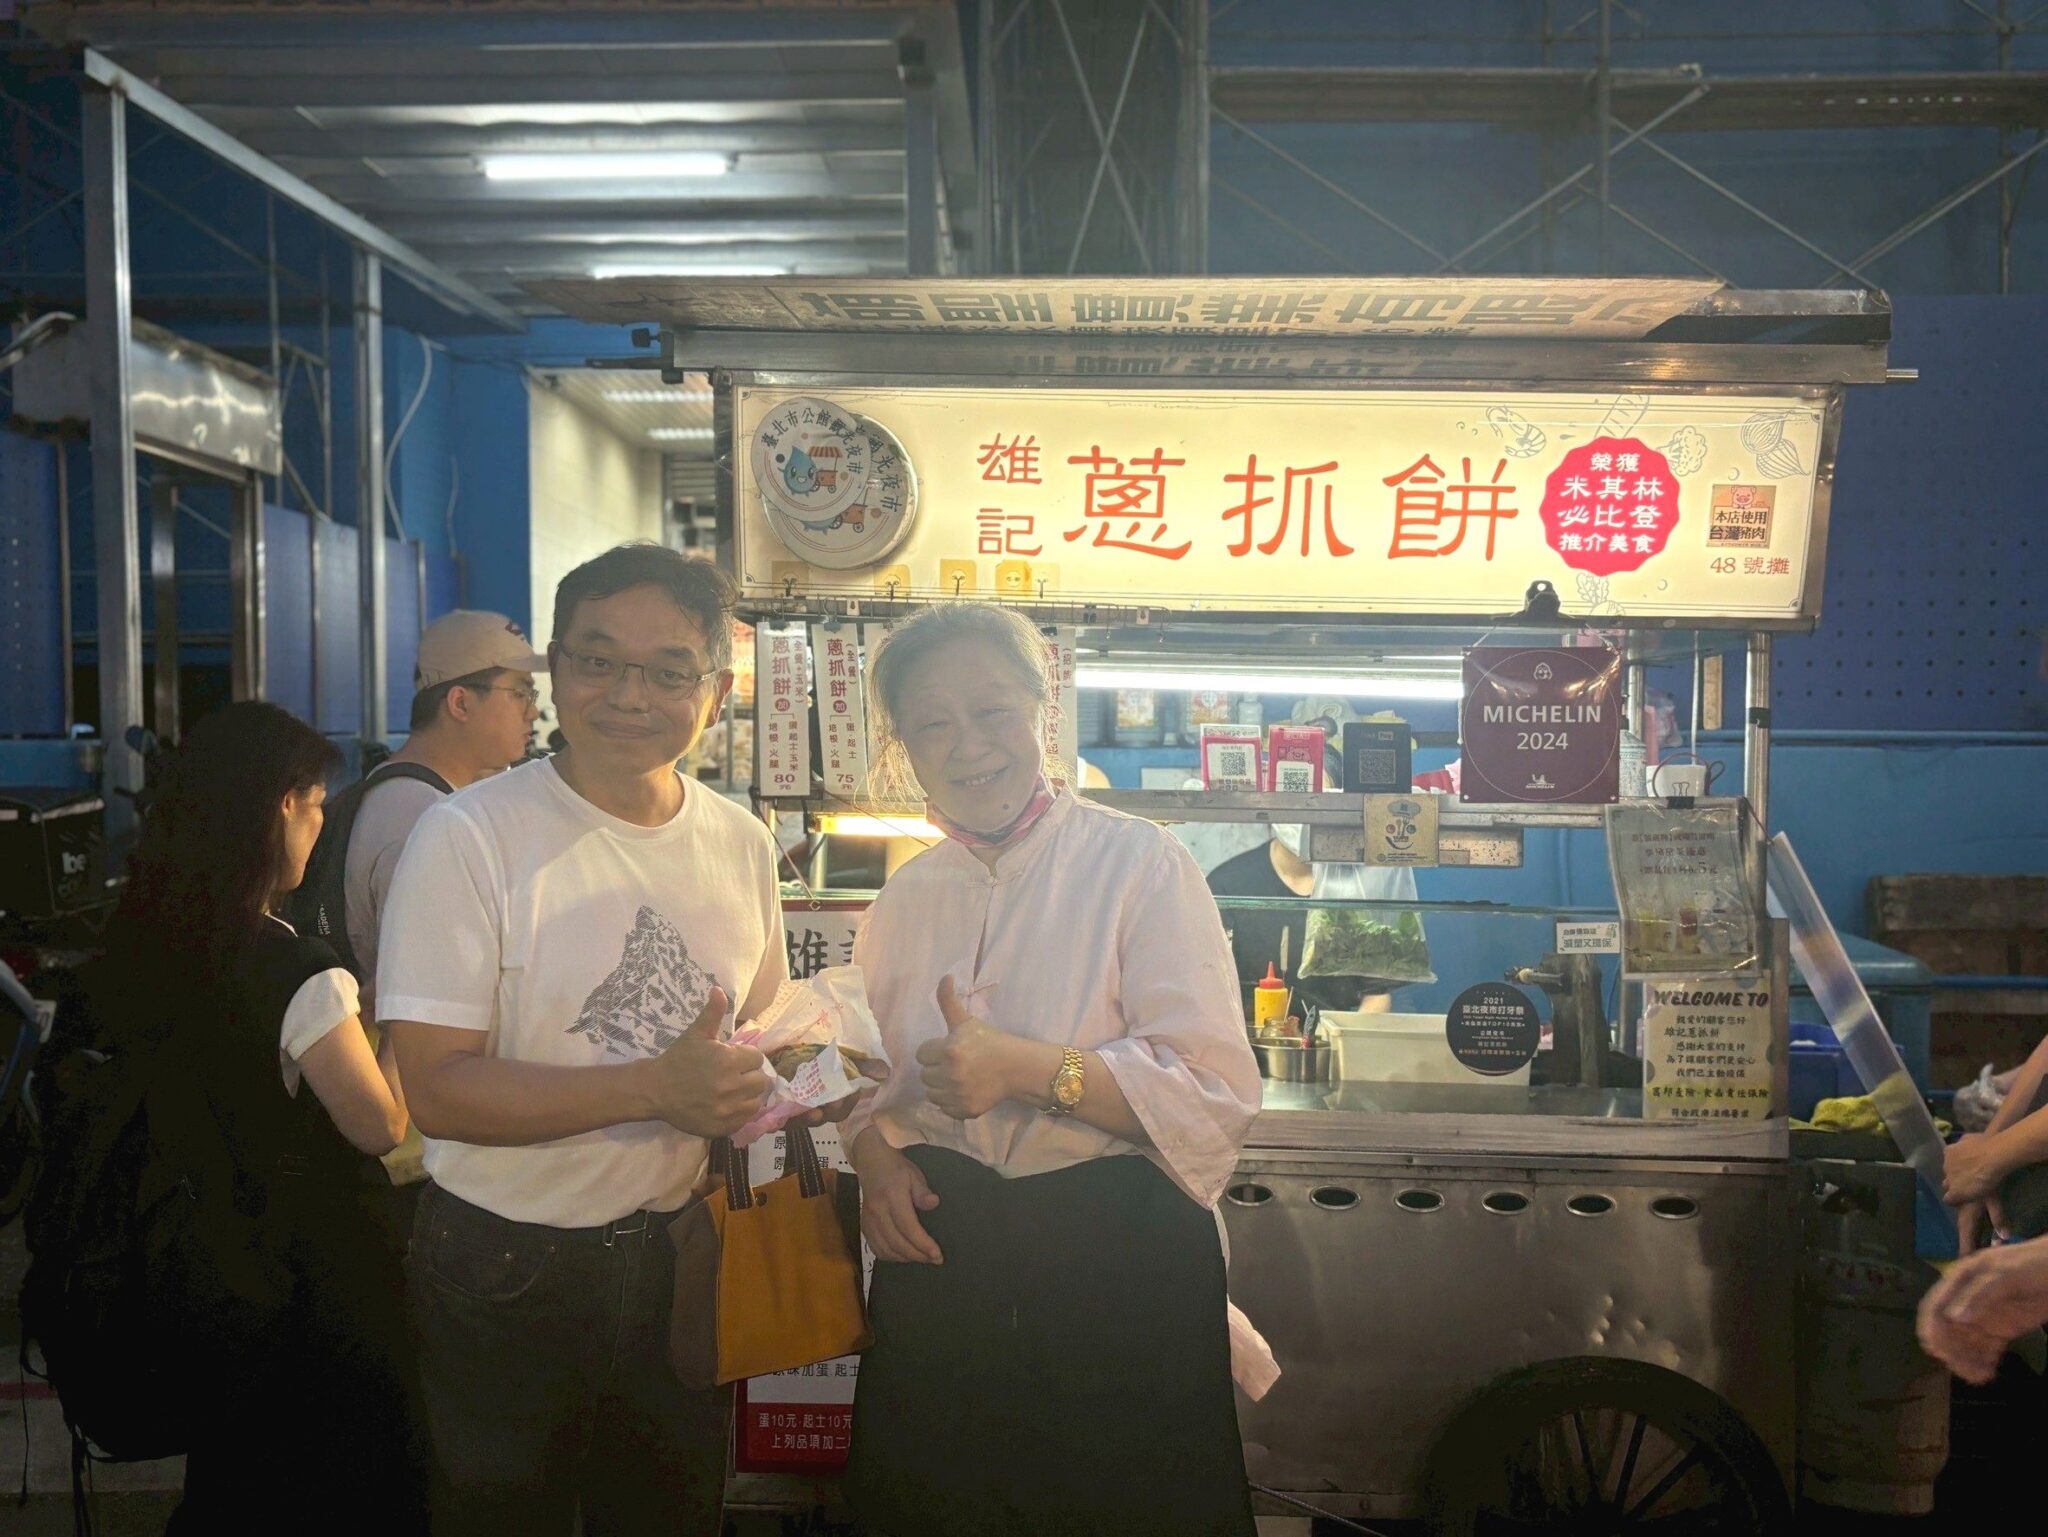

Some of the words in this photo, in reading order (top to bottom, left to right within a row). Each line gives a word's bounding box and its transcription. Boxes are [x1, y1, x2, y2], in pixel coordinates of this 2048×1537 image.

[1590, 453, 1640, 472] 榮獲
[976, 432, 1043, 557] 雄記
[1063, 444, 1519, 561] 蔥抓餅
[1560, 475, 1664, 500] 米其林
[1557, 504, 1662, 528] 必比登
[1715, 510, 1767, 525] 本店使用
[1709, 526, 1766, 540] 台灣豬肉
[1559, 533, 1655, 553] 推介美食
[1710, 557, 1736, 574] 48
[1744, 556, 1790, 574] 號攤
[827, 639, 847, 697] 蔥抓餅
[1484, 705, 1600, 723] MICHELIN
[1517, 732, 1569, 751] 2024
[774, 774, 795, 783] 80
[836, 774, 854, 783] 75
[1483, 997, 1504, 1005] 2021
[1654, 991, 1744, 1006] WELCOME
[1747, 992, 1769, 1008] TO
[771, 1434, 850, 1450] 上列品項加二
